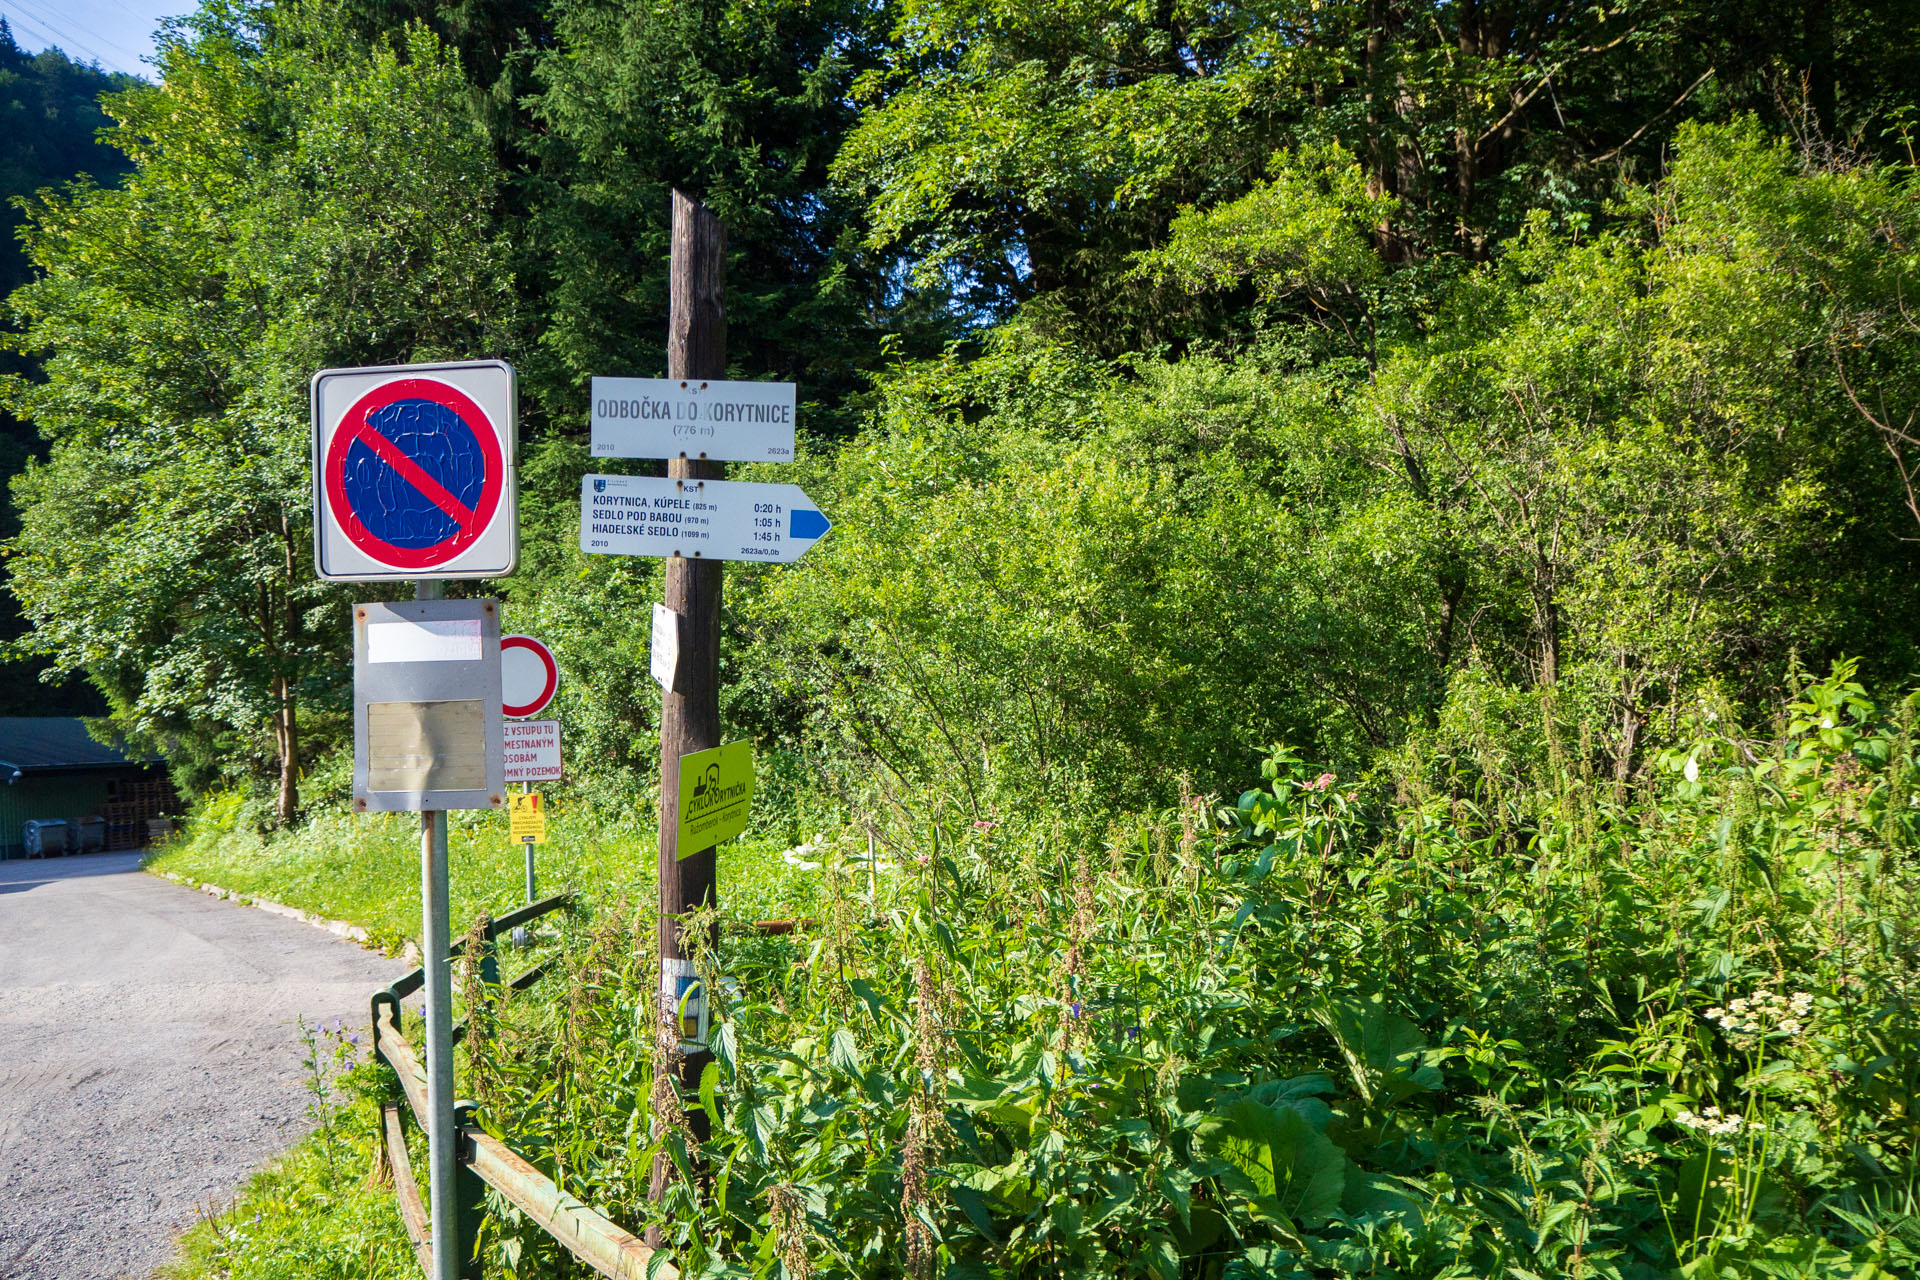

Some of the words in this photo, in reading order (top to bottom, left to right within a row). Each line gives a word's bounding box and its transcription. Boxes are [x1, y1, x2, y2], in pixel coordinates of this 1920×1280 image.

[597, 395, 671, 420] ODBOČKA
[676, 401, 698, 421] DO
[704, 402, 790, 424] KORYTNICE
[672, 425, 697, 437] (776
[700, 425, 715, 438] m)
[597, 443, 615, 451] 2010
[767, 447, 790, 455] 2623a
[683, 485, 699, 493] KST
[593, 495, 650, 508] KORYTNICA,
[654, 496, 690, 509] KÚPELE
[692, 503, 707, 511] (825
[708, 503, 718, 512] m)
[754, 504, 773, 513] 0:20
[776, 504, 782, 514] h
[592, 509, 624, 520] SEDLO
[627, 511, 647, 522] POD
[649, 512, 682, 523] BABOU
[684, 517, 699, 525] (970
[701, 517, 710, 525] m)
[754, 518, 773, 527] 1:05
[775, 519, 781, 528] h
[592, 523, 645, 536] HIADEĽSKÉ
[647, 526, 679, 537] SEDLO
[681, 530, 700, 539] (1099
[701, 532, 710, 540] m)
[753, 532, 772, 541] 1:45
[774, 532, 780, 542] h
[741, 547, 780, 556] 2623a/0,0b
[511, 725, 542, 736] VSTUPU
[544, 725, 554, 735] TU
[503, 737, 554, 750] MESTNANÝM
[526, 766, 561, 777] POZEMOK
